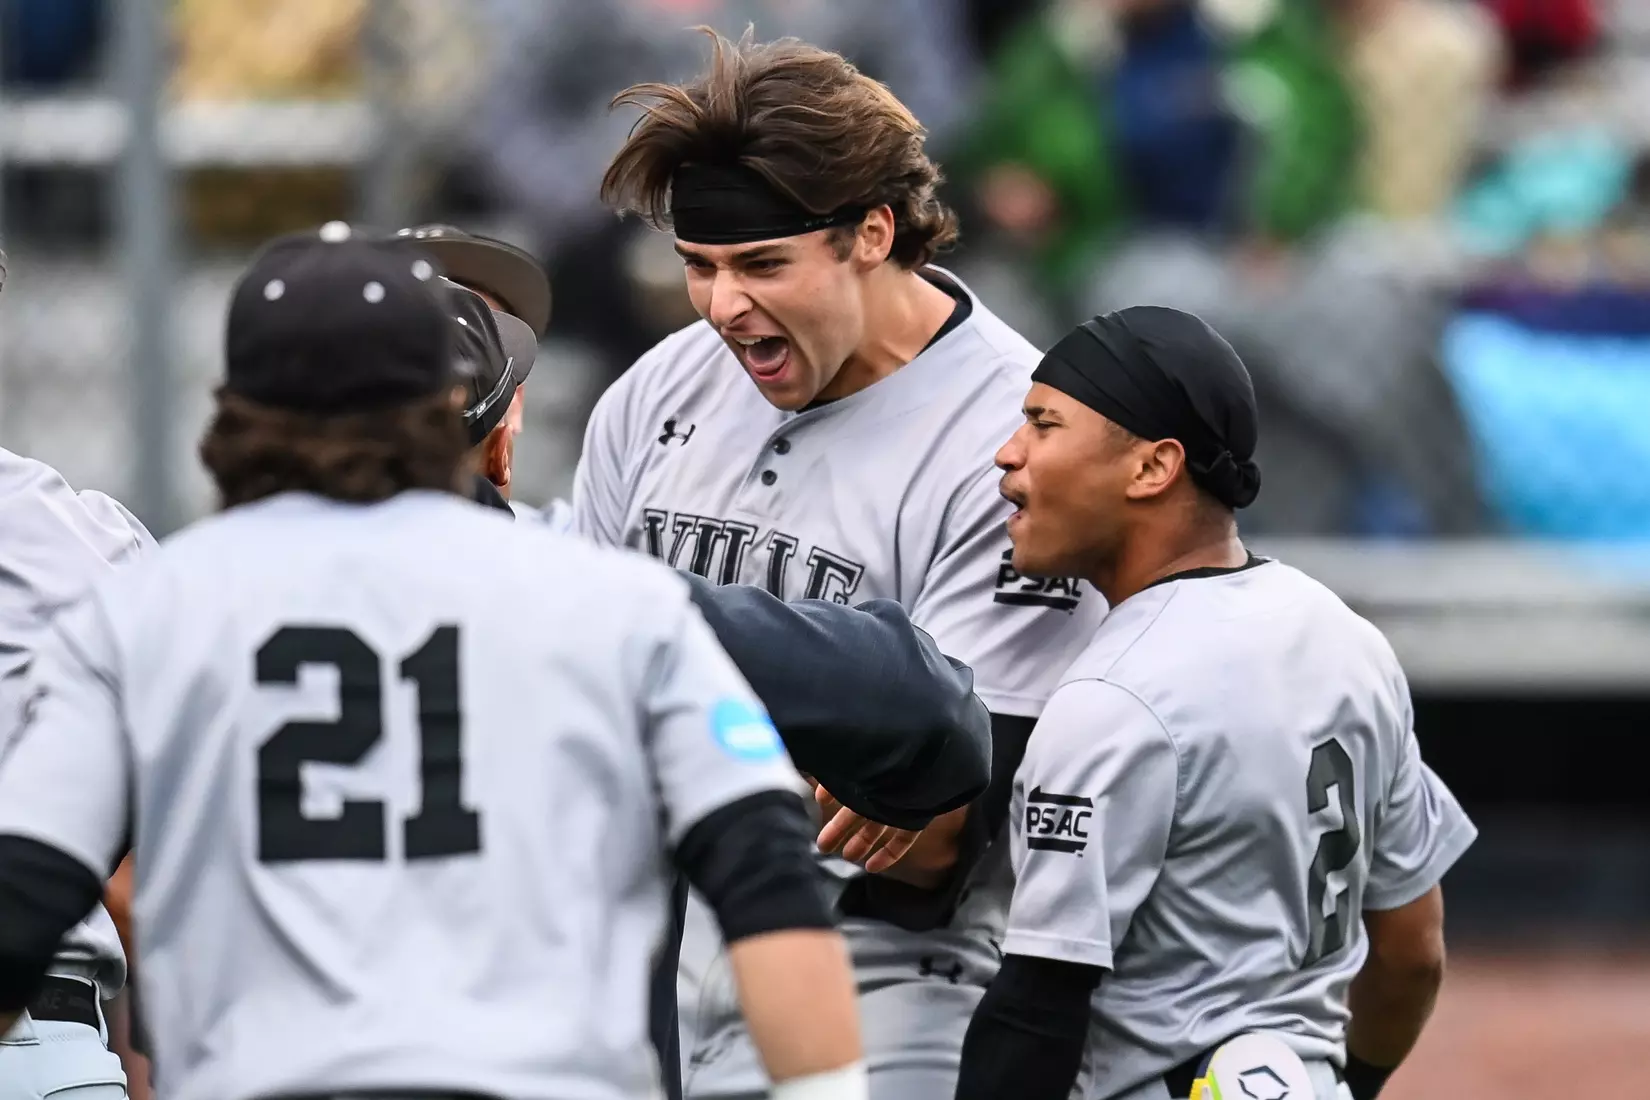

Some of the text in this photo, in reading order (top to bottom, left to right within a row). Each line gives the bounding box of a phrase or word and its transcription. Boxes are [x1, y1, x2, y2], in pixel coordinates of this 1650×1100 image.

[254, 624, 482, 863] 21
[1026, 806, 1092, 839] PSAC
[1301, 736, 1360, 969] 2
